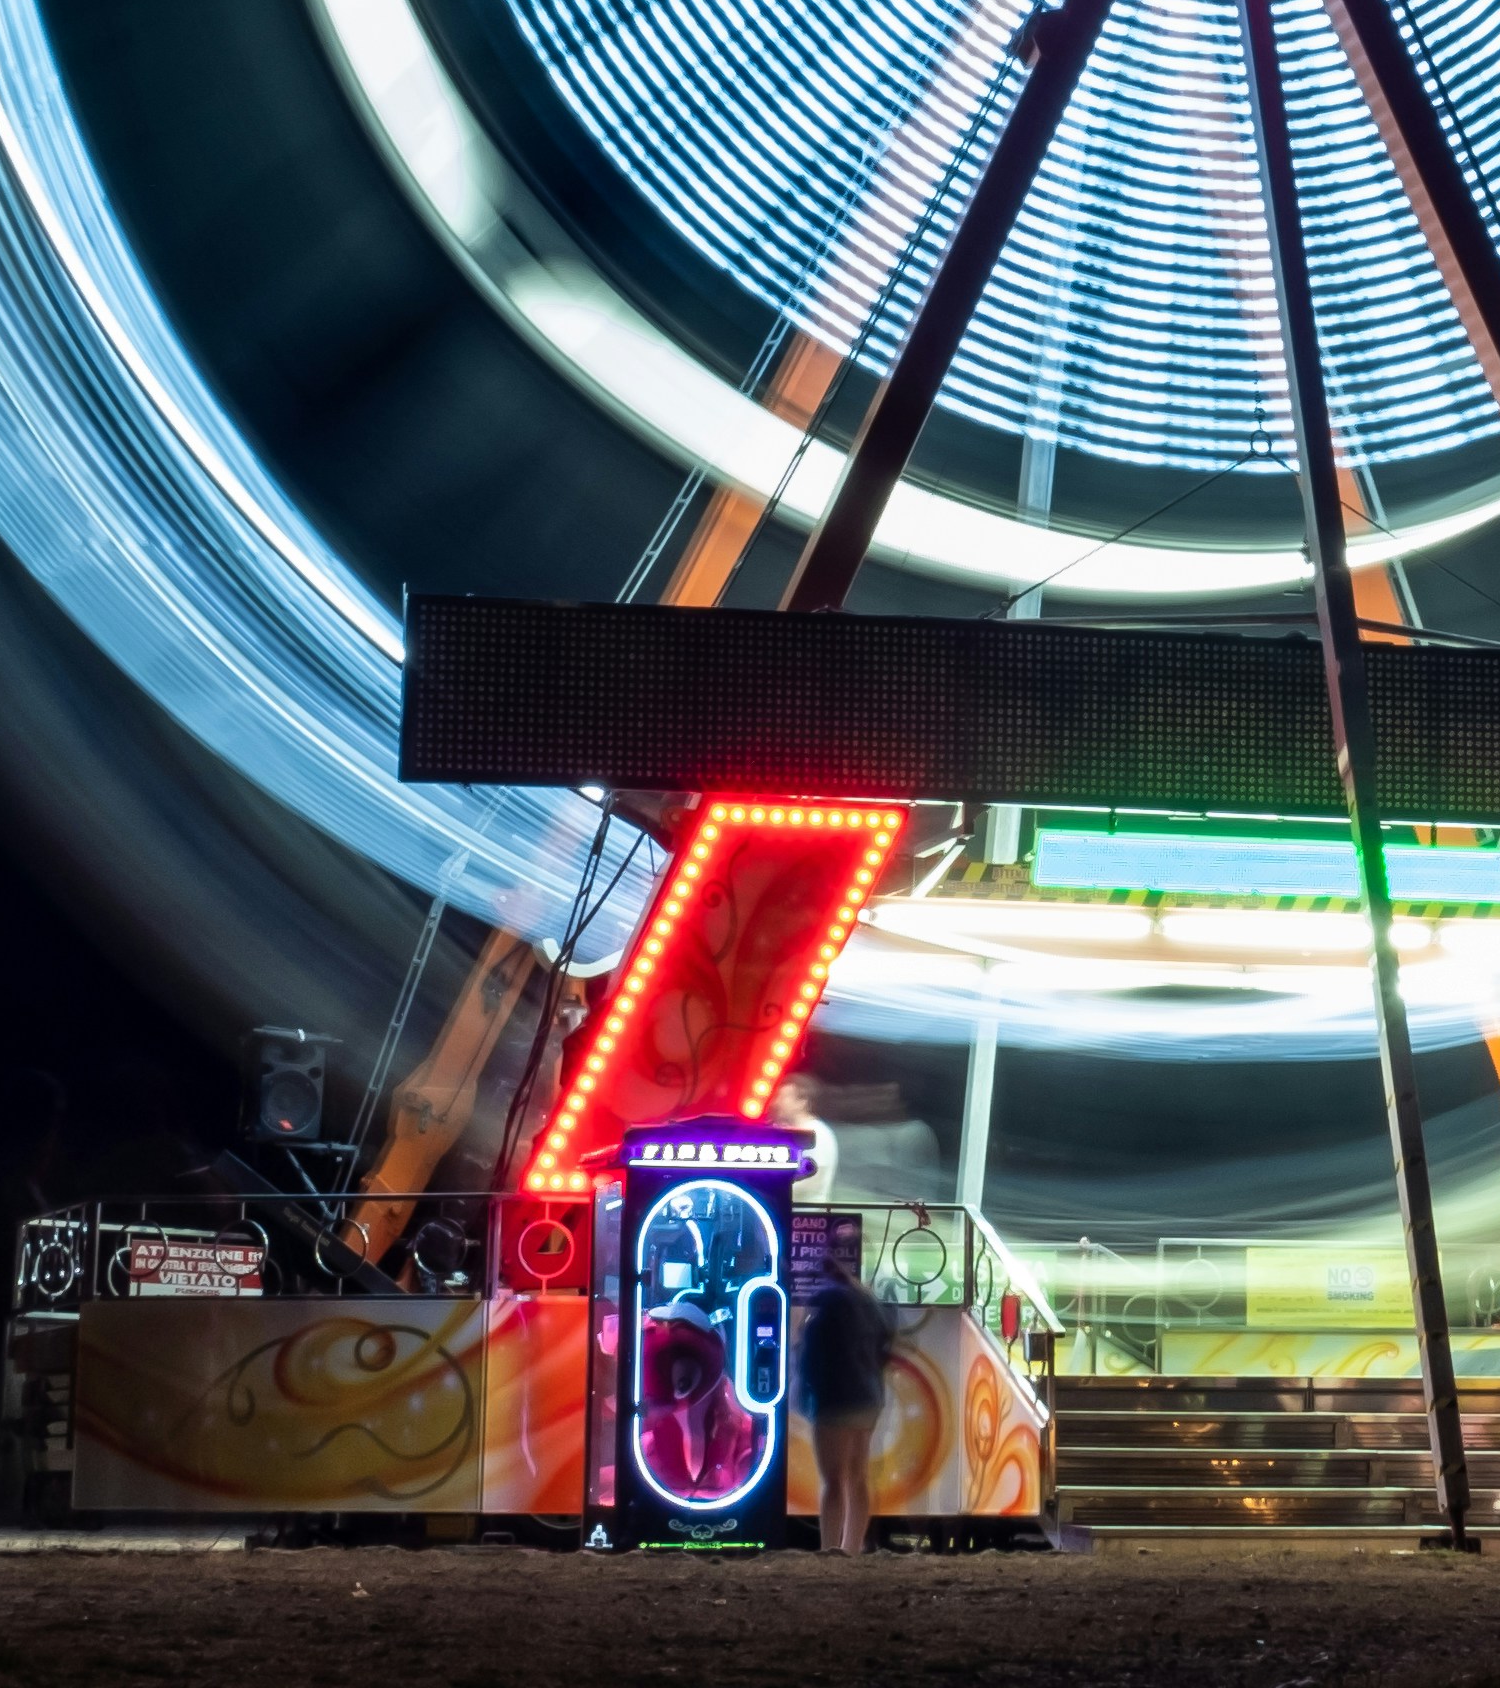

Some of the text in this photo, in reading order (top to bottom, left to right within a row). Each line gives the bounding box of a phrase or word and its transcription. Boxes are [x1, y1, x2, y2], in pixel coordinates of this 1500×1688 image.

[159, 1271, 236, 1287] VIETATO
[1327, 1268, 1351, 1285] NO
[1327, 1290, 1374, 1301] SMOKING
